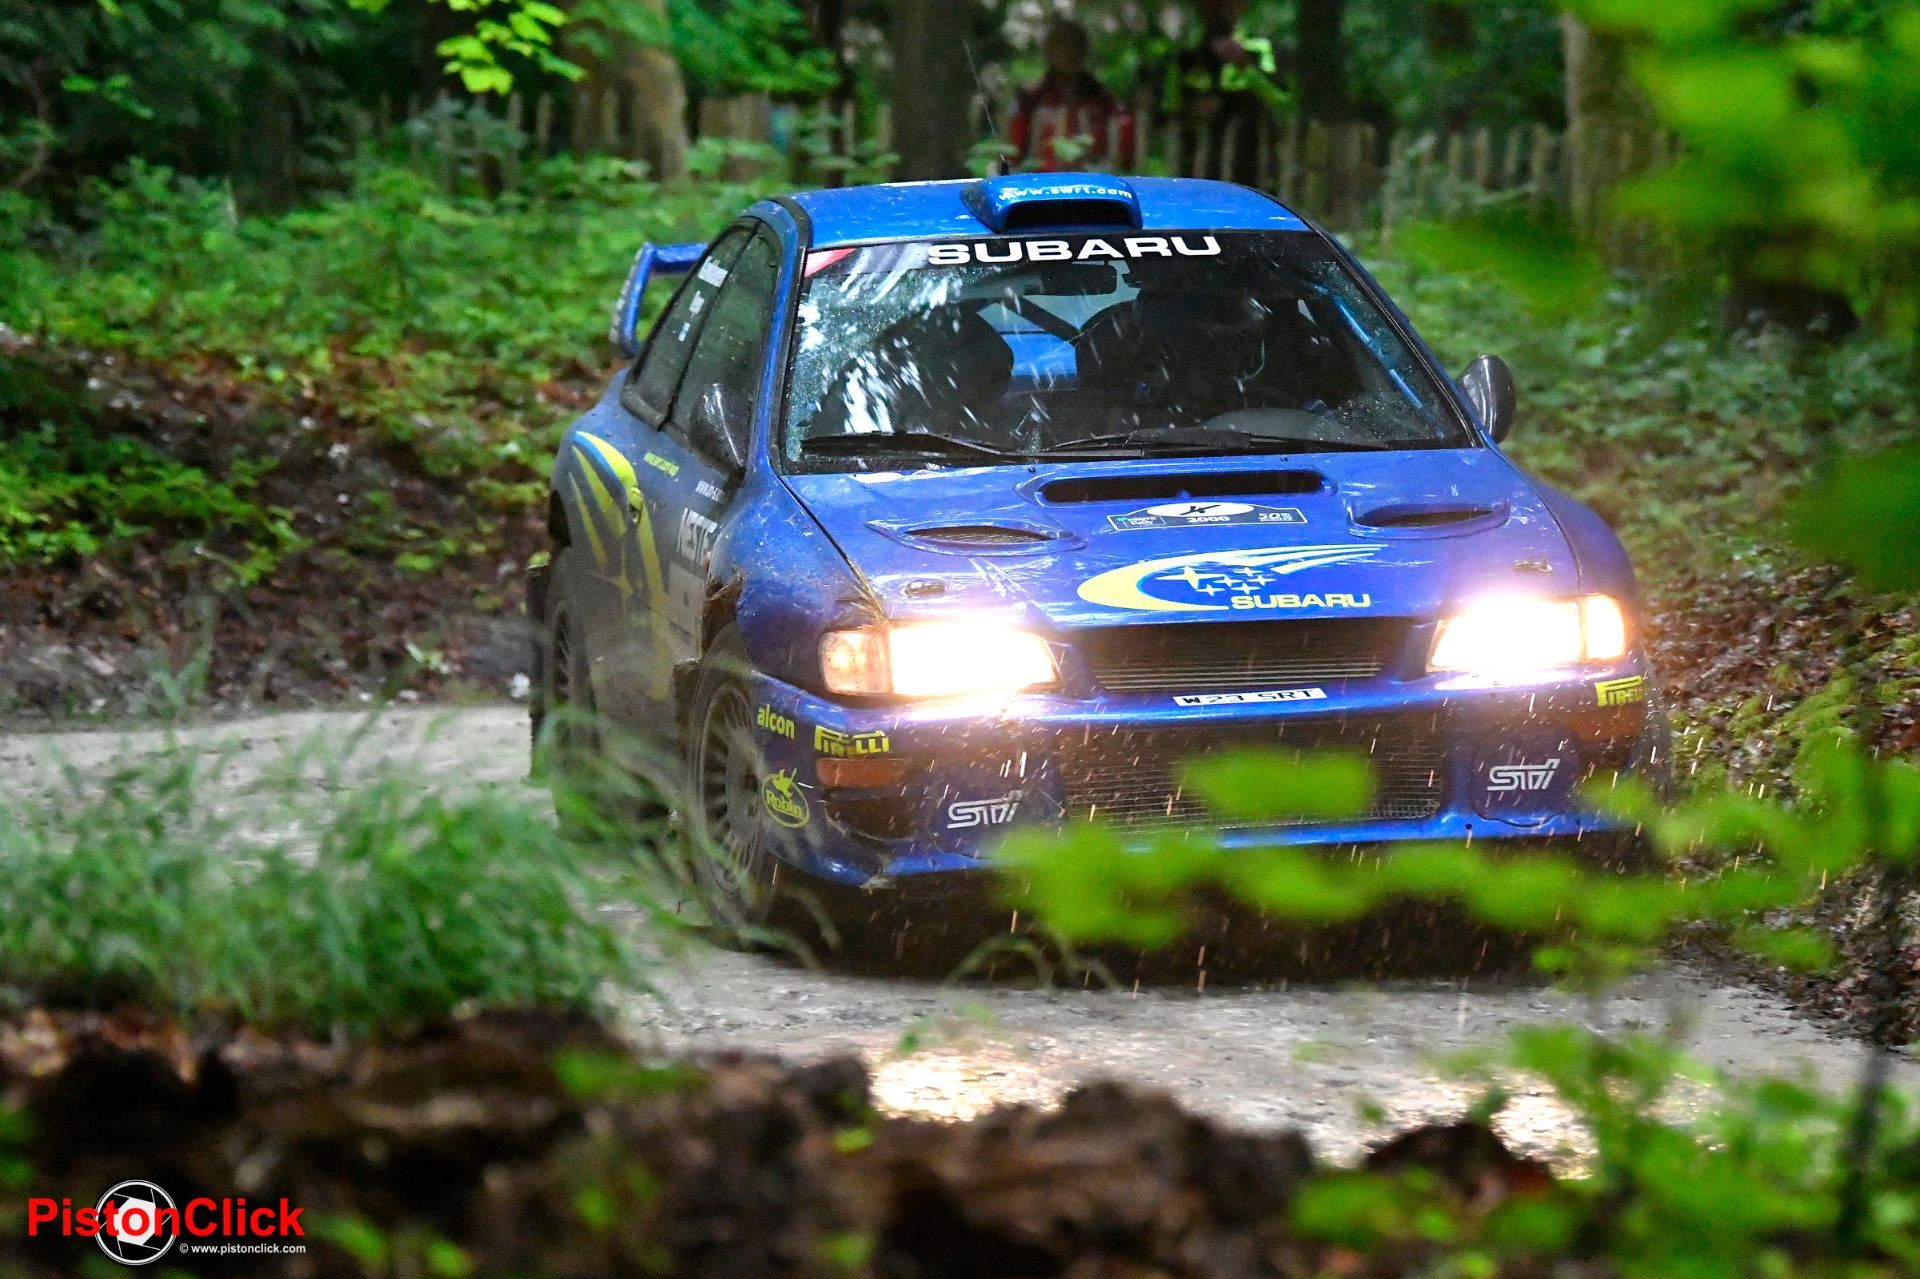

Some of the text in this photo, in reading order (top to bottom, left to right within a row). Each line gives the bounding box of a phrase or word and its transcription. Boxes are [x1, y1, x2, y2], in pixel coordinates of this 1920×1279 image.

[998, 186, 1133, 200] www.swrt.com
[928, 236, 1221, 264] SUBARU
[1186, 515, 1231, 523] 2000
[1230, 592, 1372, 610] SUBARU
[1257, 689, 1313, 700] SRT
[757, 703, 795, 740] alcon
